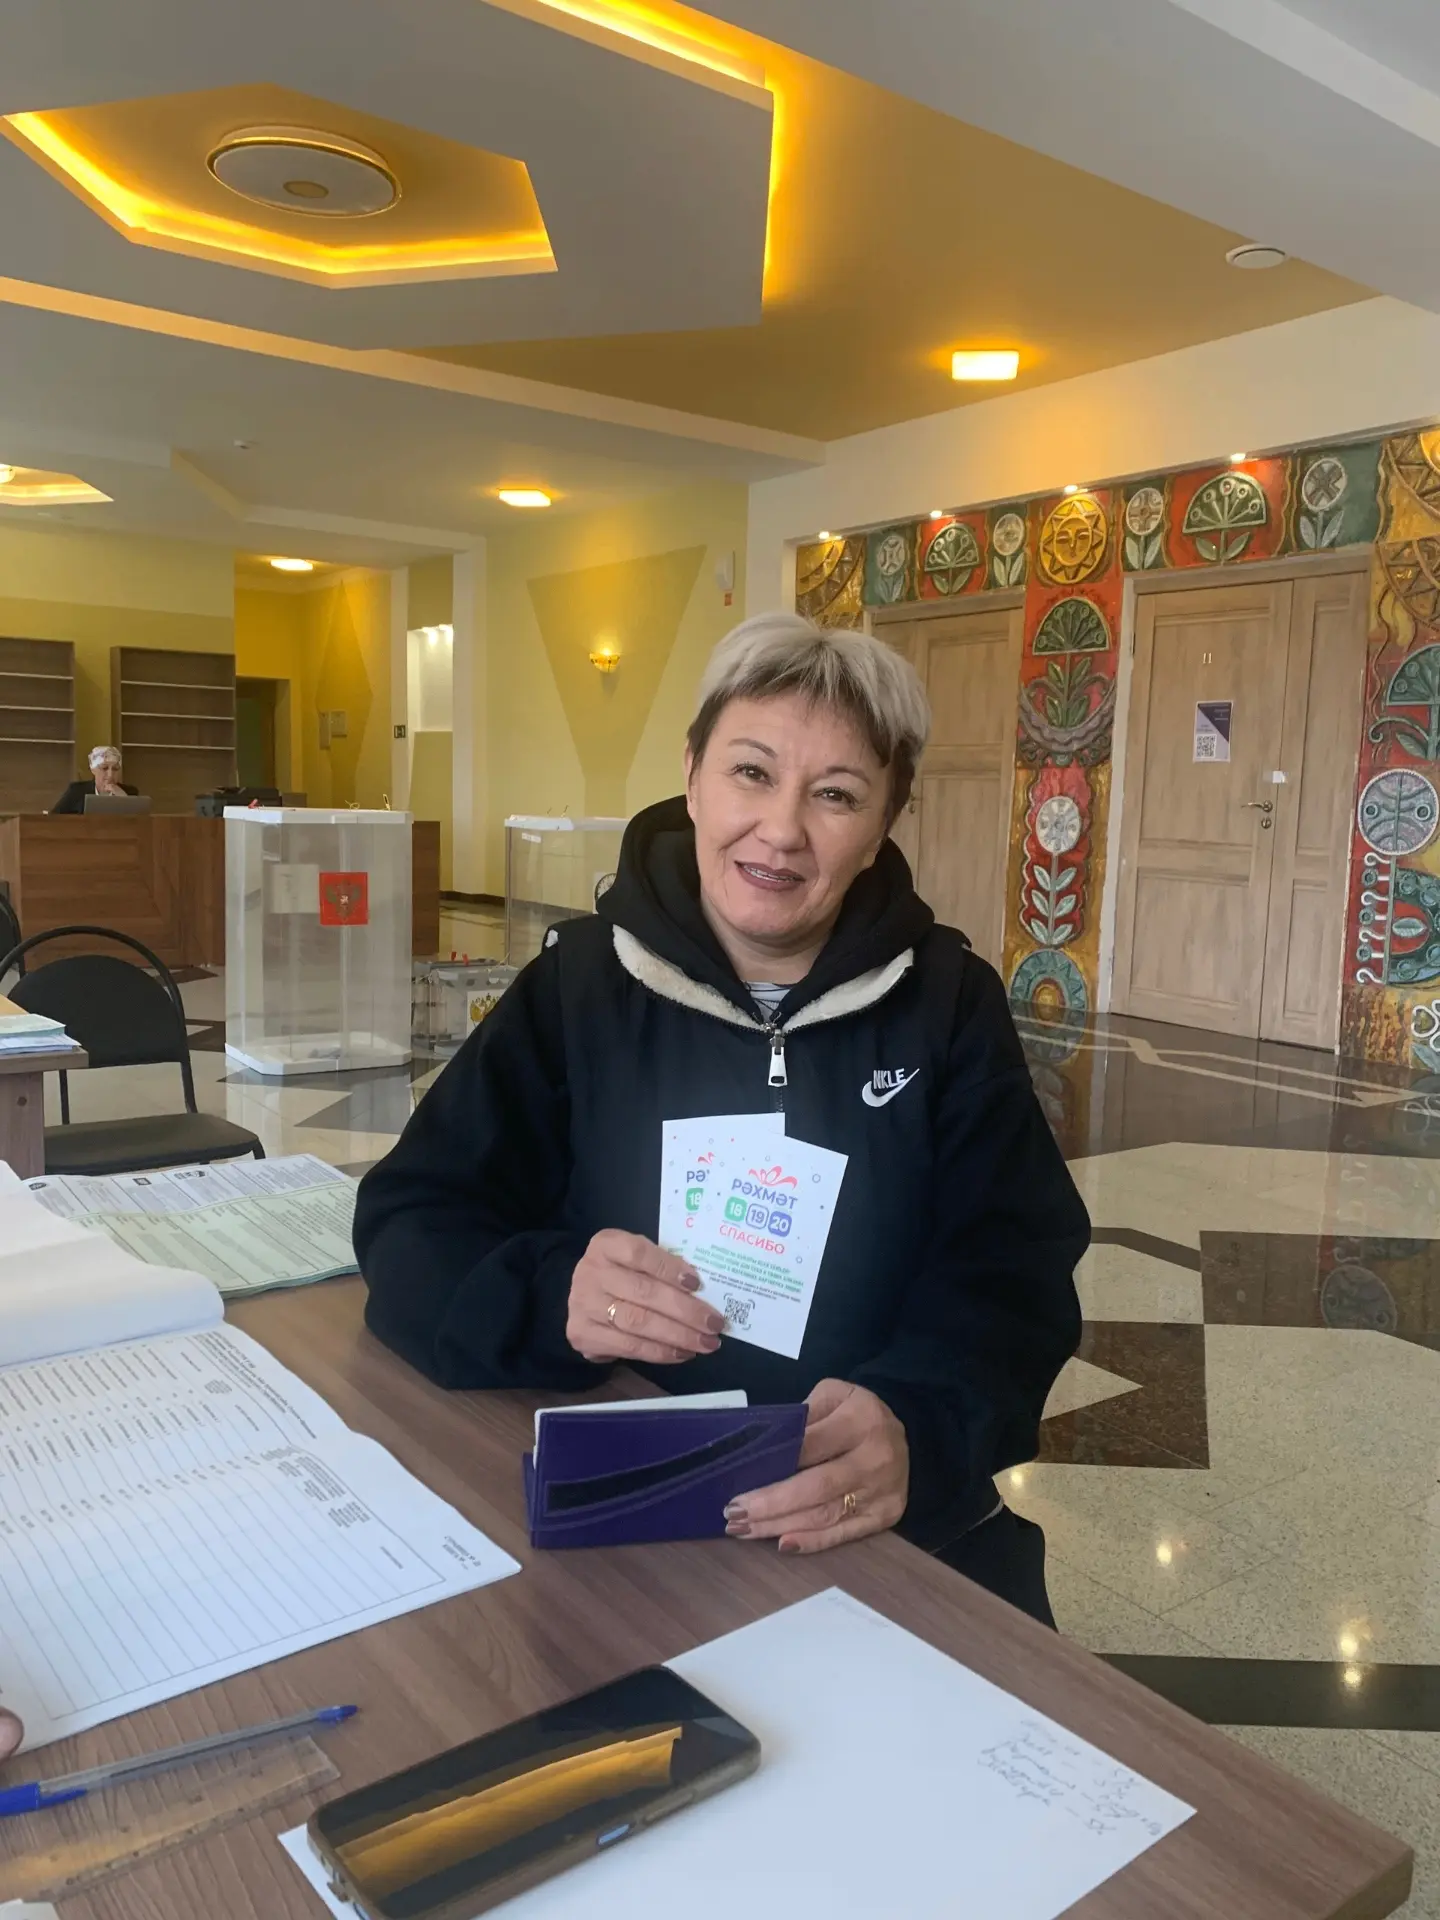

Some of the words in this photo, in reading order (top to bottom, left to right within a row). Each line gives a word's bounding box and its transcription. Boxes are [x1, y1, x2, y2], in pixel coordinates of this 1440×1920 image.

[731, 1178, 798, 1210] РӘХМӘТ
[730, 1201, 744, 1217] 18
[751, 1209, 765, 1224] 19
[770, 1215, 790, 1233] 20
[719, 1224, 785, 1254] СПАСИБО
